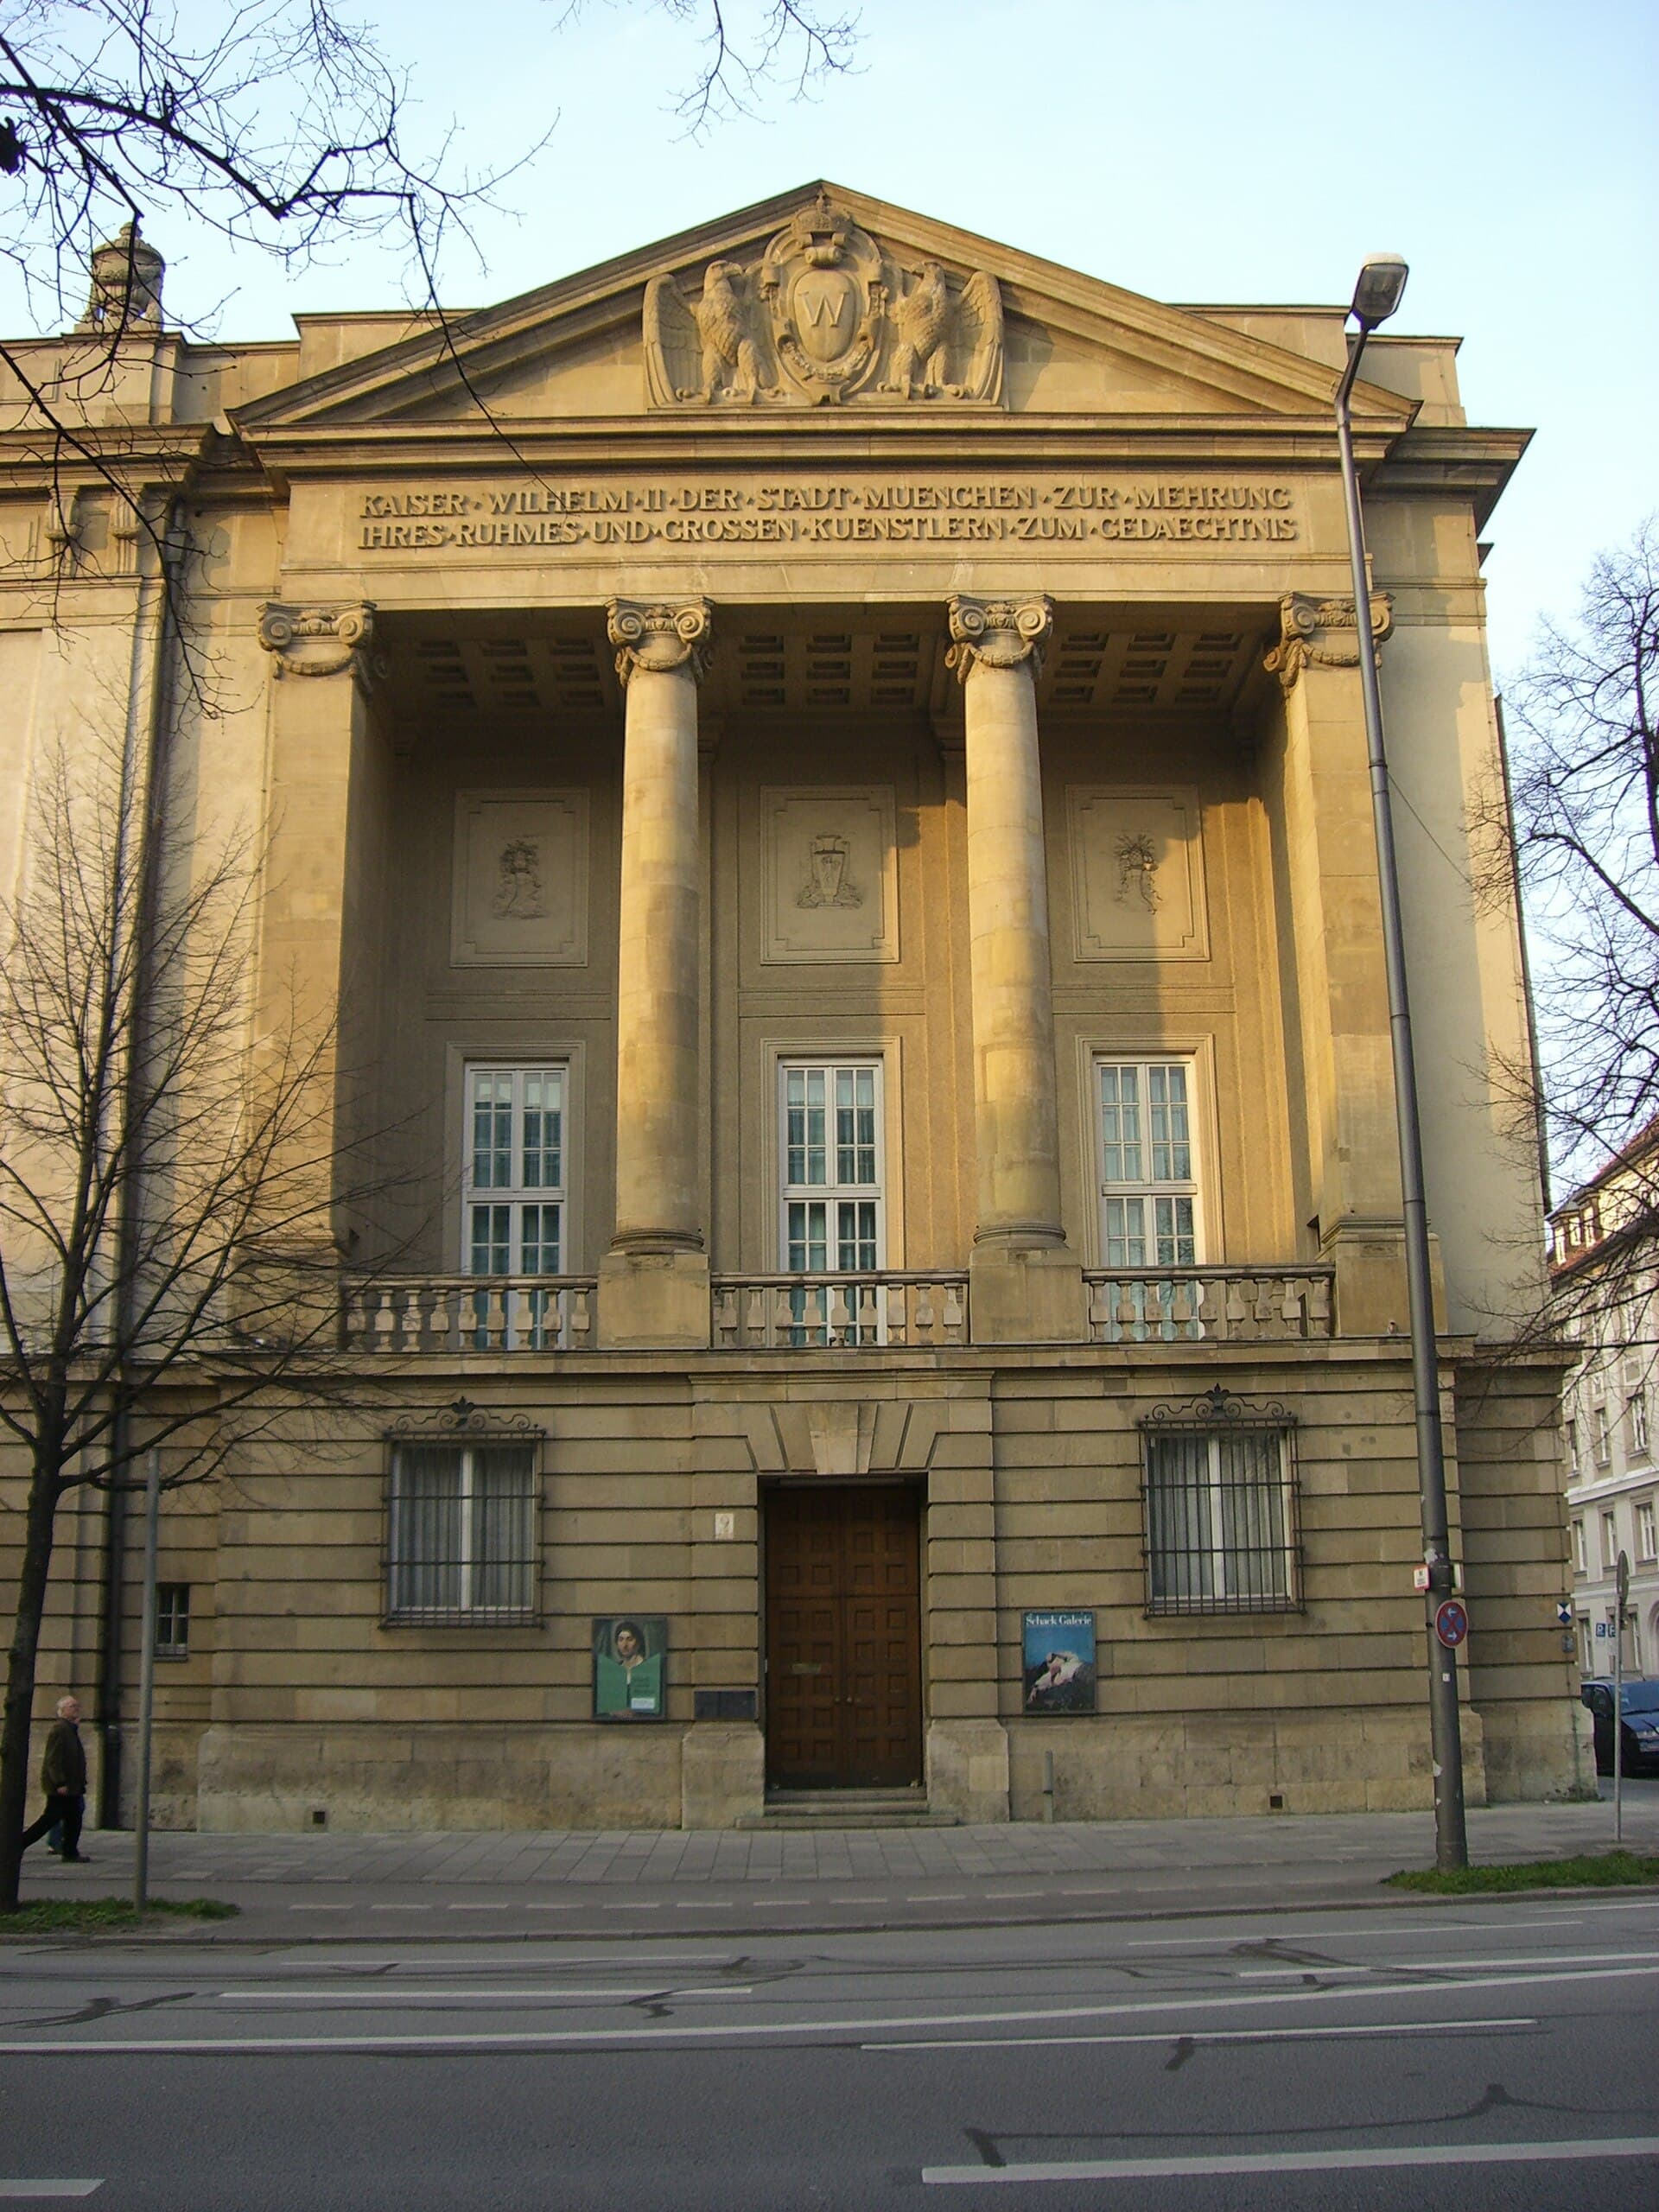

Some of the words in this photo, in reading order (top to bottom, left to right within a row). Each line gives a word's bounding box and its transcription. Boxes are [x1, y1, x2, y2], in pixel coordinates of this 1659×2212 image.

[798, 290, 849, 327] W
[359, 493, 468, 518] KAISER
[489, 489, 629, 514] WILHELM
[642, 487, 664, 512] II
[677, 486, 741, 511] DER
[757, 486, 851, 510] STADT
[863, 485, 1039, 510] MUENCHEN
[1052, 486, 1118, 510] ZUR
[1134, 486, 1292, 510] MEHRUNG
[358, 523, 448, 550] IHRES
[454, 520, 582, 547] RUHMES
[591, 518, 652, 543] UND
[659, 517, 795, 543] GROSSEN
[810, 516, 1005, 541] KUENSTLERN
[1017, 516, 1084, 541] ZUM
[1099, 516, 1300, 541] GEDAECHTNIS
[1026, 1613, 1057, 1625] Schack
[1058, 1613, 1092, 1625] Galerie
